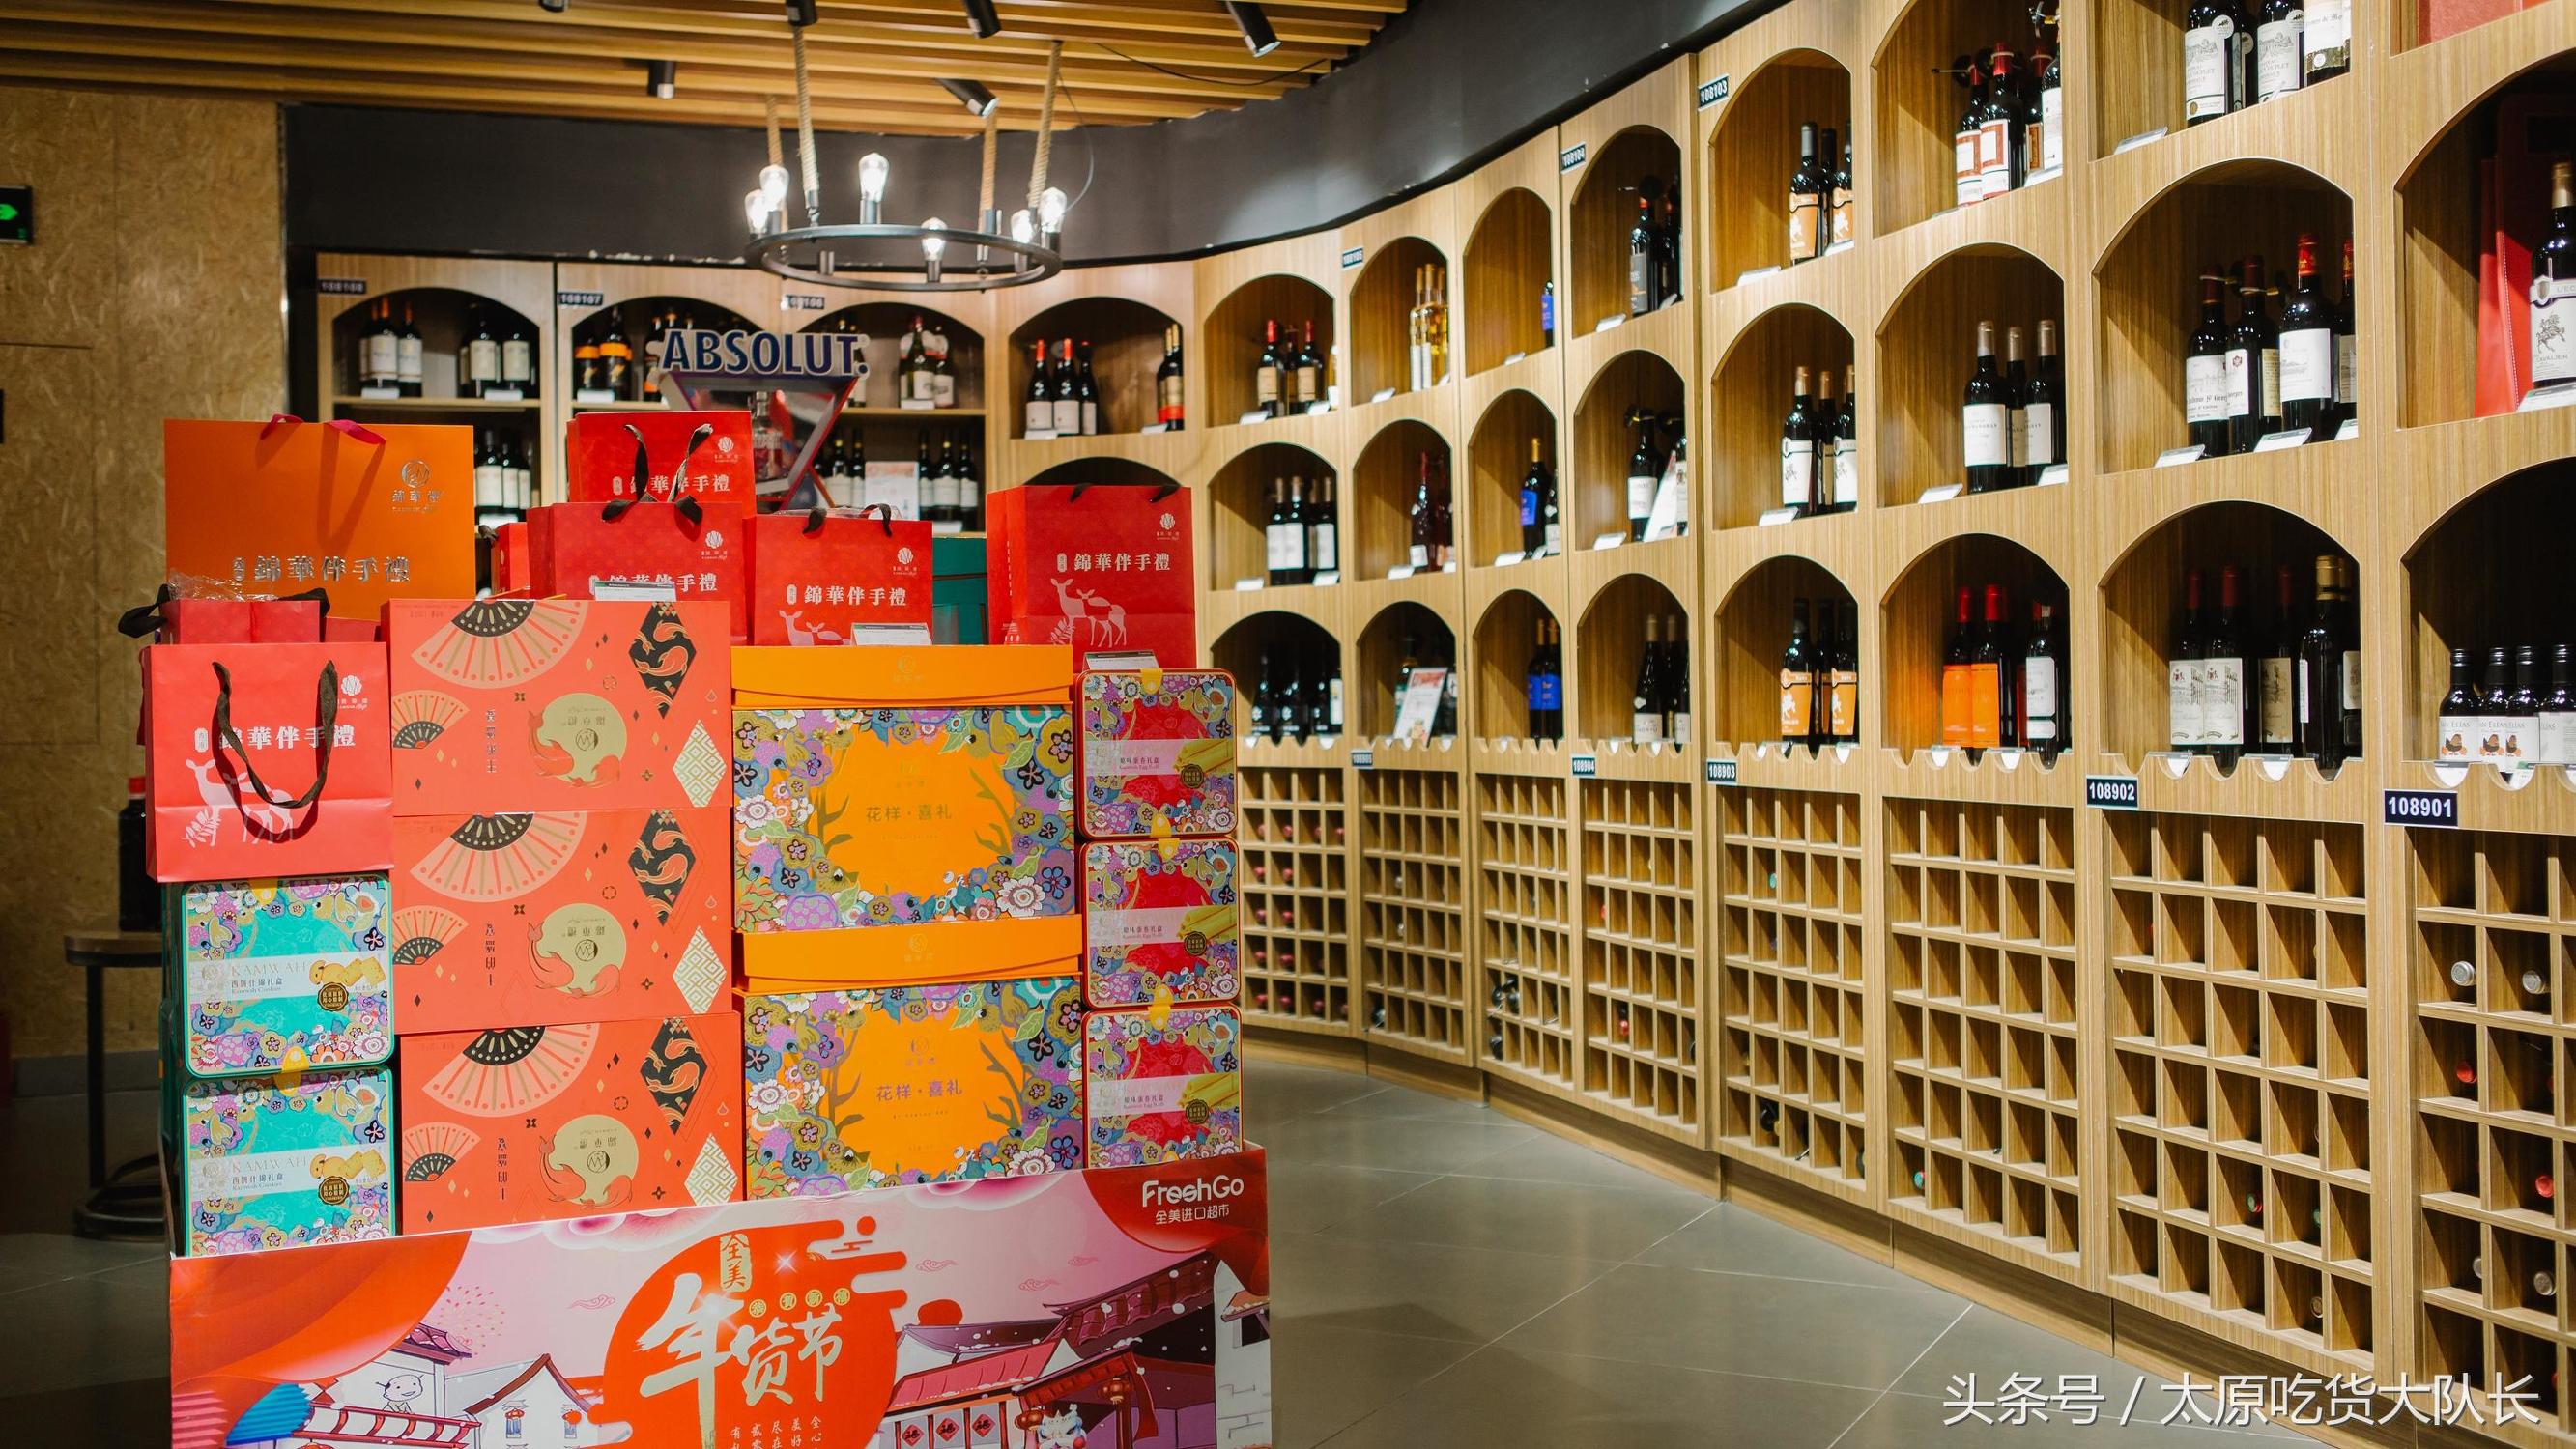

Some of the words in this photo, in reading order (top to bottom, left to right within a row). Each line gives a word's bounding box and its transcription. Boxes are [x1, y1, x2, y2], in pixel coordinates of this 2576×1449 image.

[1701, 79, 1728, 103] 108103
[254, 555, 410, 582] 錦華伴手禮
[1073, 553, 1170, 572] 錦華伴手禮
[803, 584, 907, 607] 錦華伴手禮
[1708, 764, 1736, 779] 108903
[2089, 782, 2135, 801] 108902
[2388, 796, 2452, 818] 108901
[1142, 1174, 1245, 1208] FreshGo
[1155, 1204, 1230, 1225] 全美进口超市
[722, 1234, 750, 1289] 全美
[633, 1272, 843, 1449] 年货节
